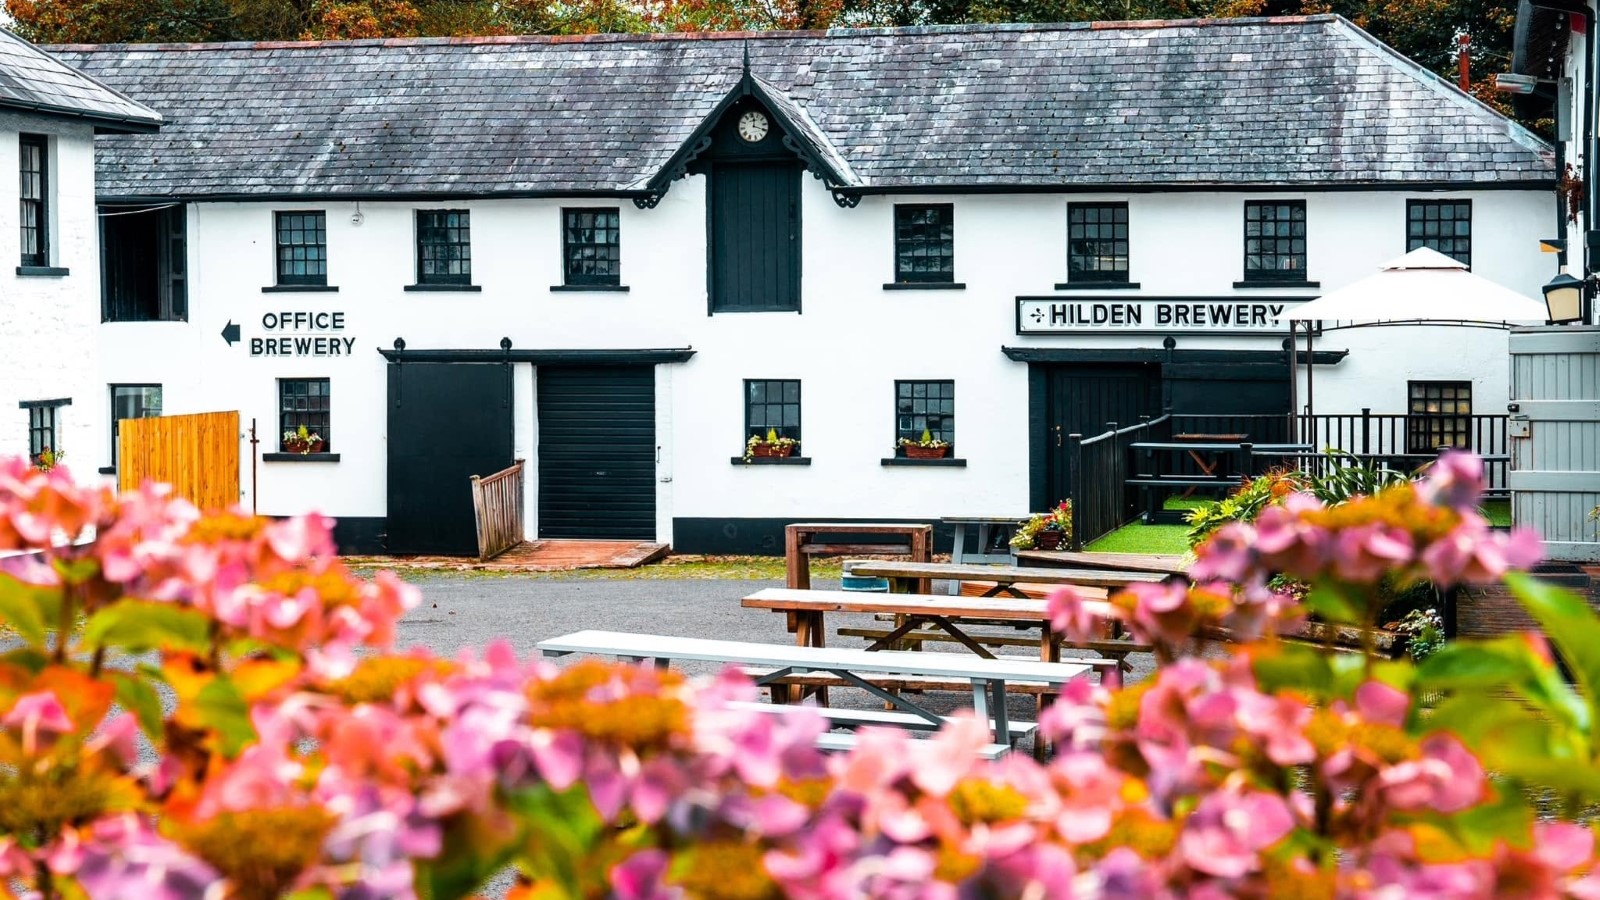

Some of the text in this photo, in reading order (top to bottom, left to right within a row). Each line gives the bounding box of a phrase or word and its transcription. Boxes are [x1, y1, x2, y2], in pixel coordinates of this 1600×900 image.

[262, 312, 345, 330] OFFICE
[1050, 304, 1285, 326] HILDEN BREWERY
[250, 337, 356, 356] BREWERY
